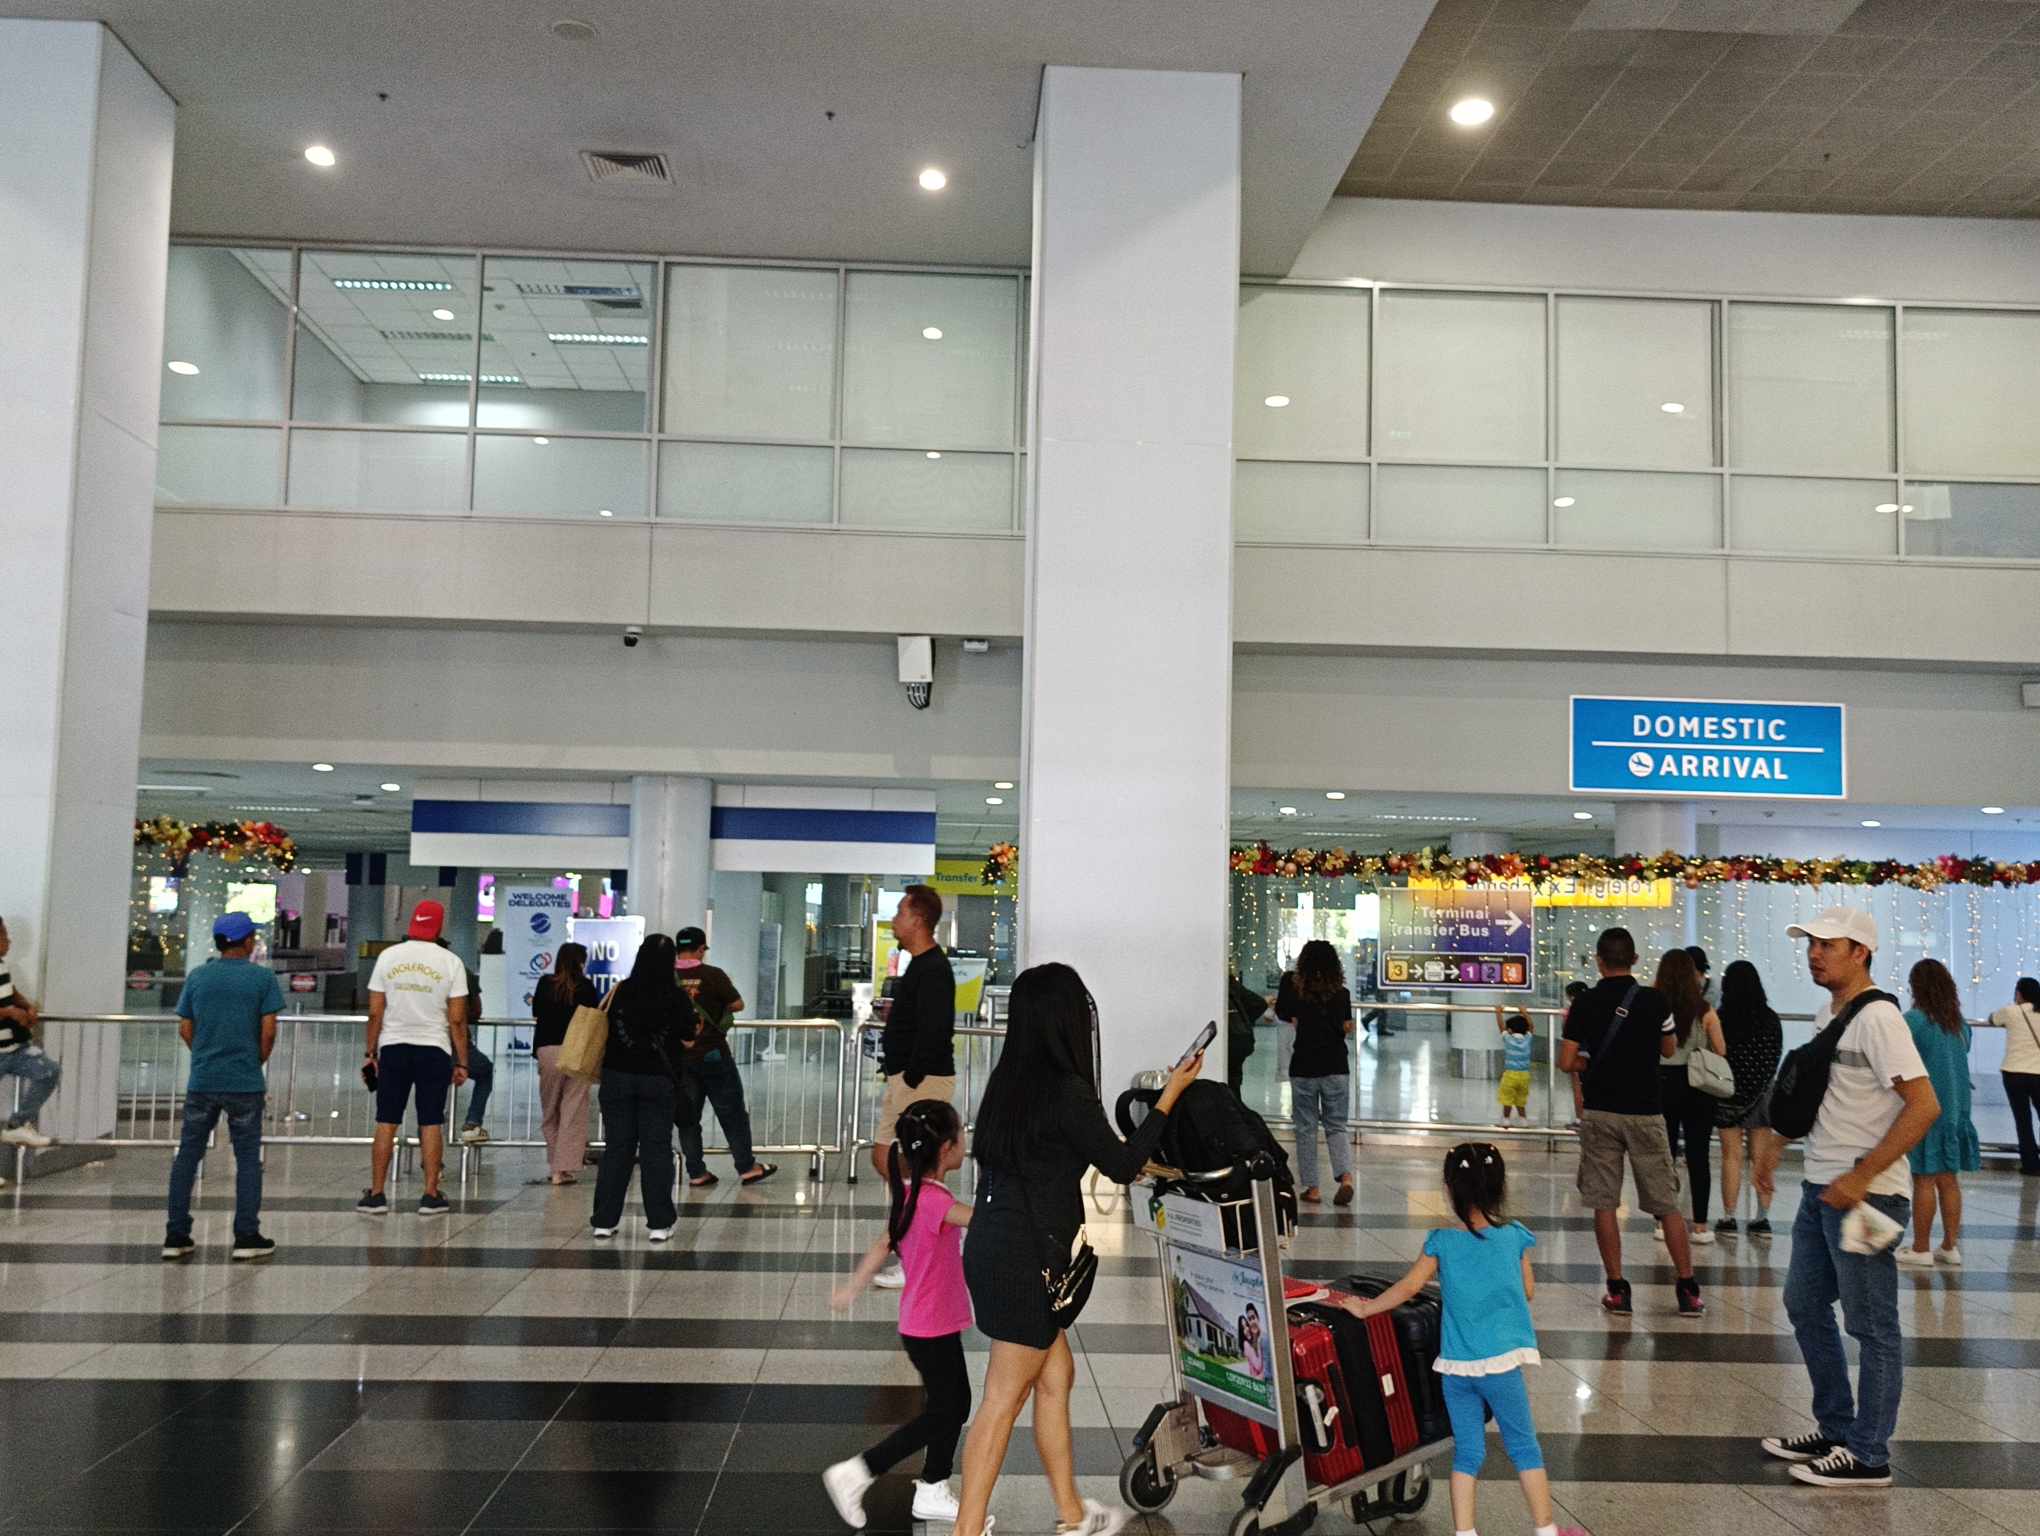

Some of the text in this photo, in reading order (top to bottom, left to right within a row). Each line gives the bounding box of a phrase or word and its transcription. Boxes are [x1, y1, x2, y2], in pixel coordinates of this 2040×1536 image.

[1632, 714, 1787, 741] DOMESTIC
[1658, 754, 1789, 780] ARRIVAL
[936, 872, 979, 882] Transfer
[512, 892, 568, 900] WELCOME
[508, 900, 571, 908] DELEGATES
[1421, 906, 1490, 920] Terminal
[1390, 923, 1490, 937] Transfer Bus
[591, 940, 620, 961] NO
[1393, 965, 1403, 976] 3
[1466, 965, 1475, 979] 1
[1487, 966, 1496, 979] 2
